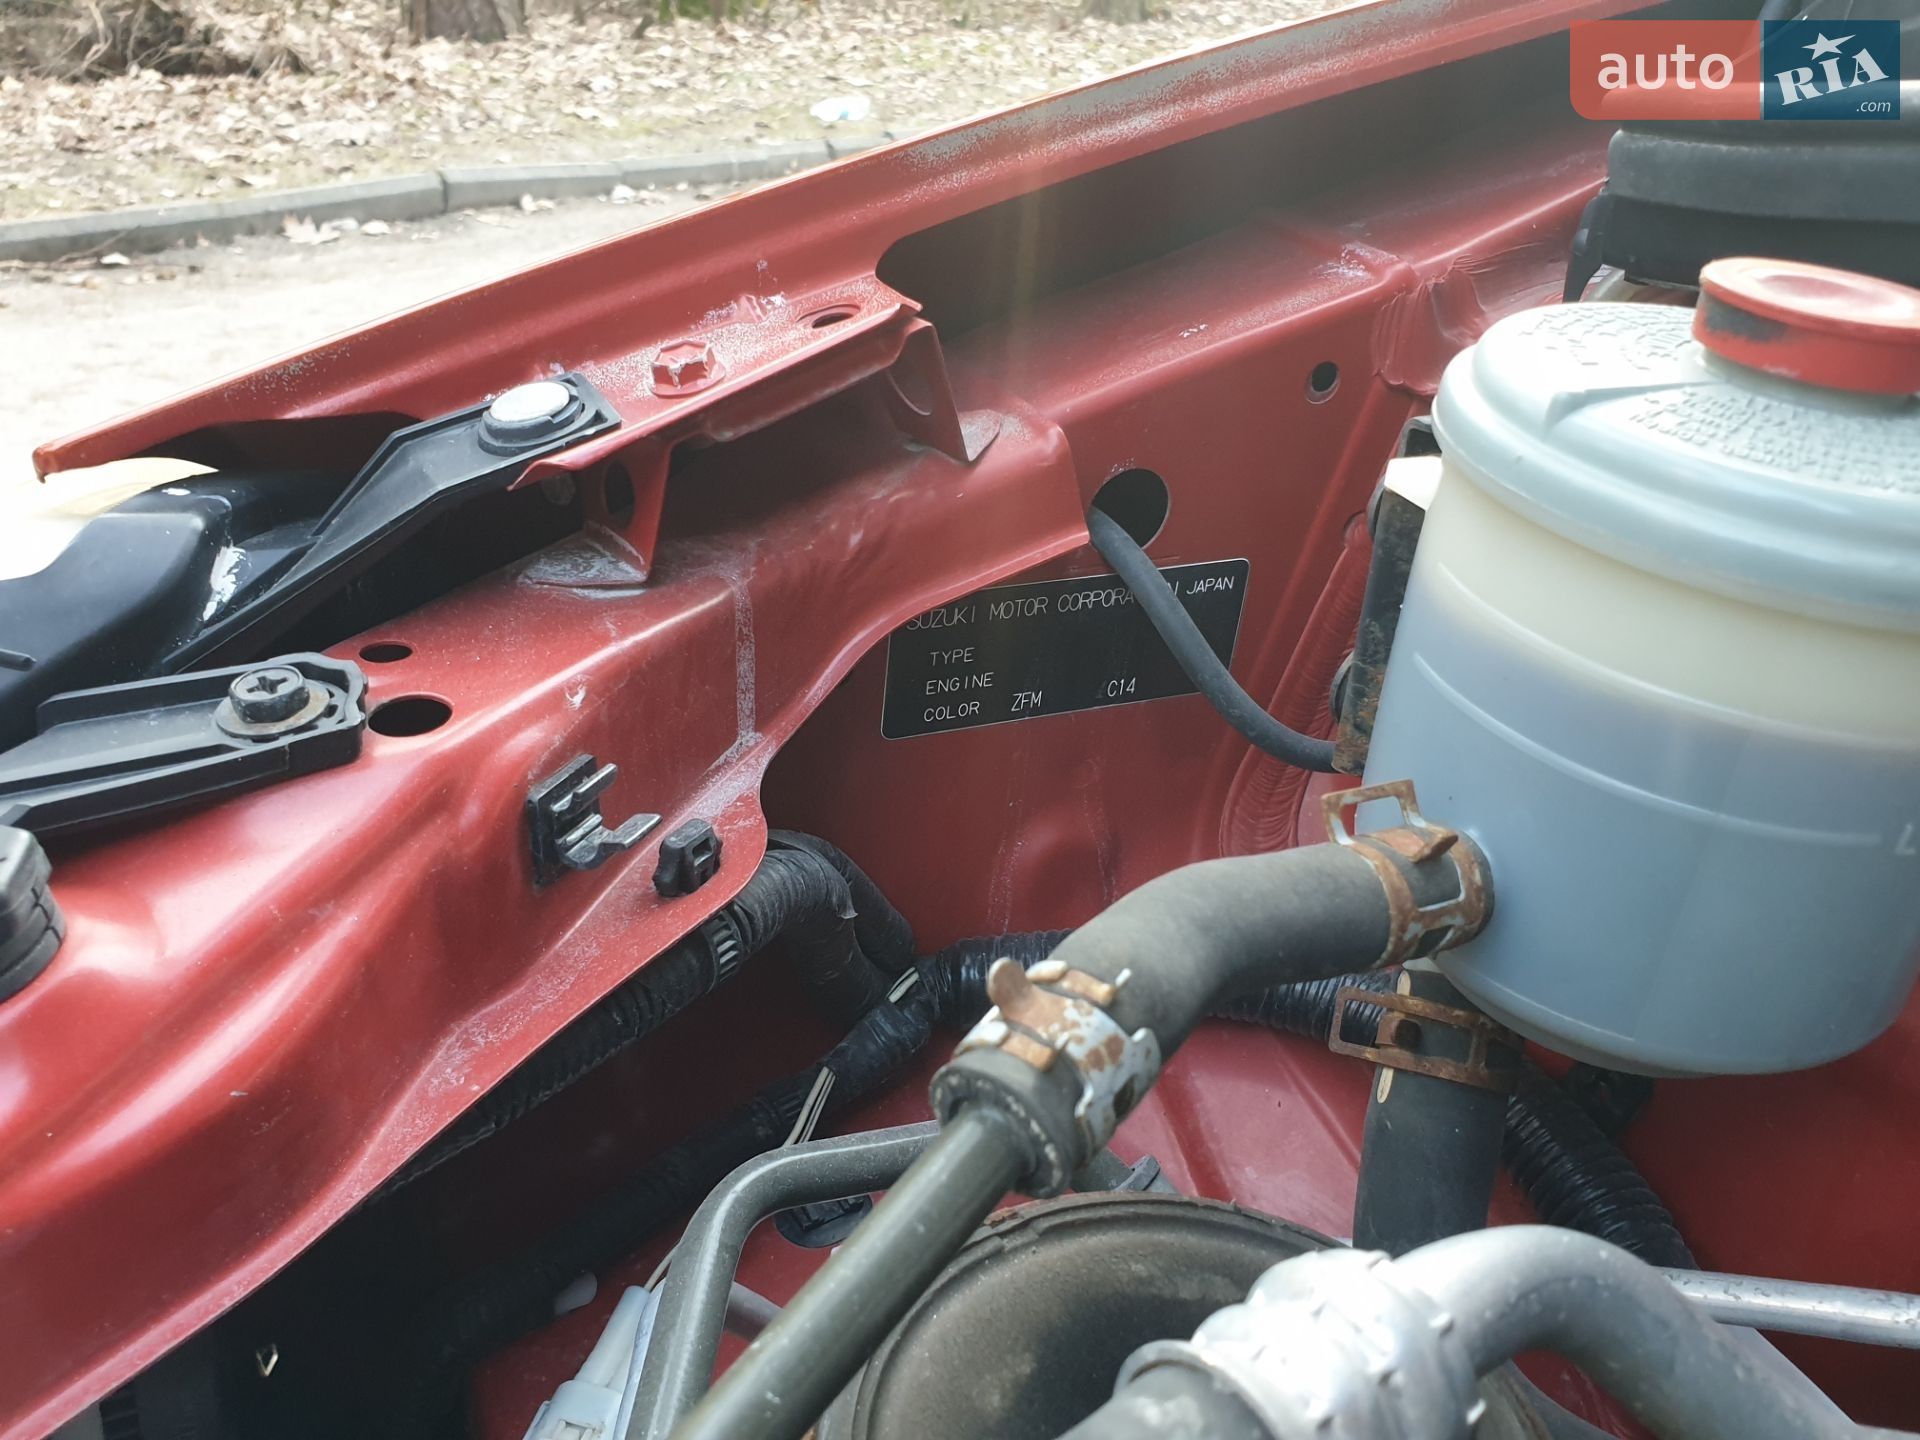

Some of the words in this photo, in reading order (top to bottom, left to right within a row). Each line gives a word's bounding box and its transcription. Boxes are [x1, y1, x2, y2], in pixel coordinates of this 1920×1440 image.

[905, 605, 977, 632] SUZUKI
[988, 596, 1049, 622] MOTOR
[1185, 575, 1235, 596] JAPAN
[929, 647, 976, 666] TYPE
[923, 701, 980, 722] COLOR
[1010, 690, 1043, 712] ZFM
[1106, 677, 1137, 698] C14
[925, 671, 995, 696] ENGINE
